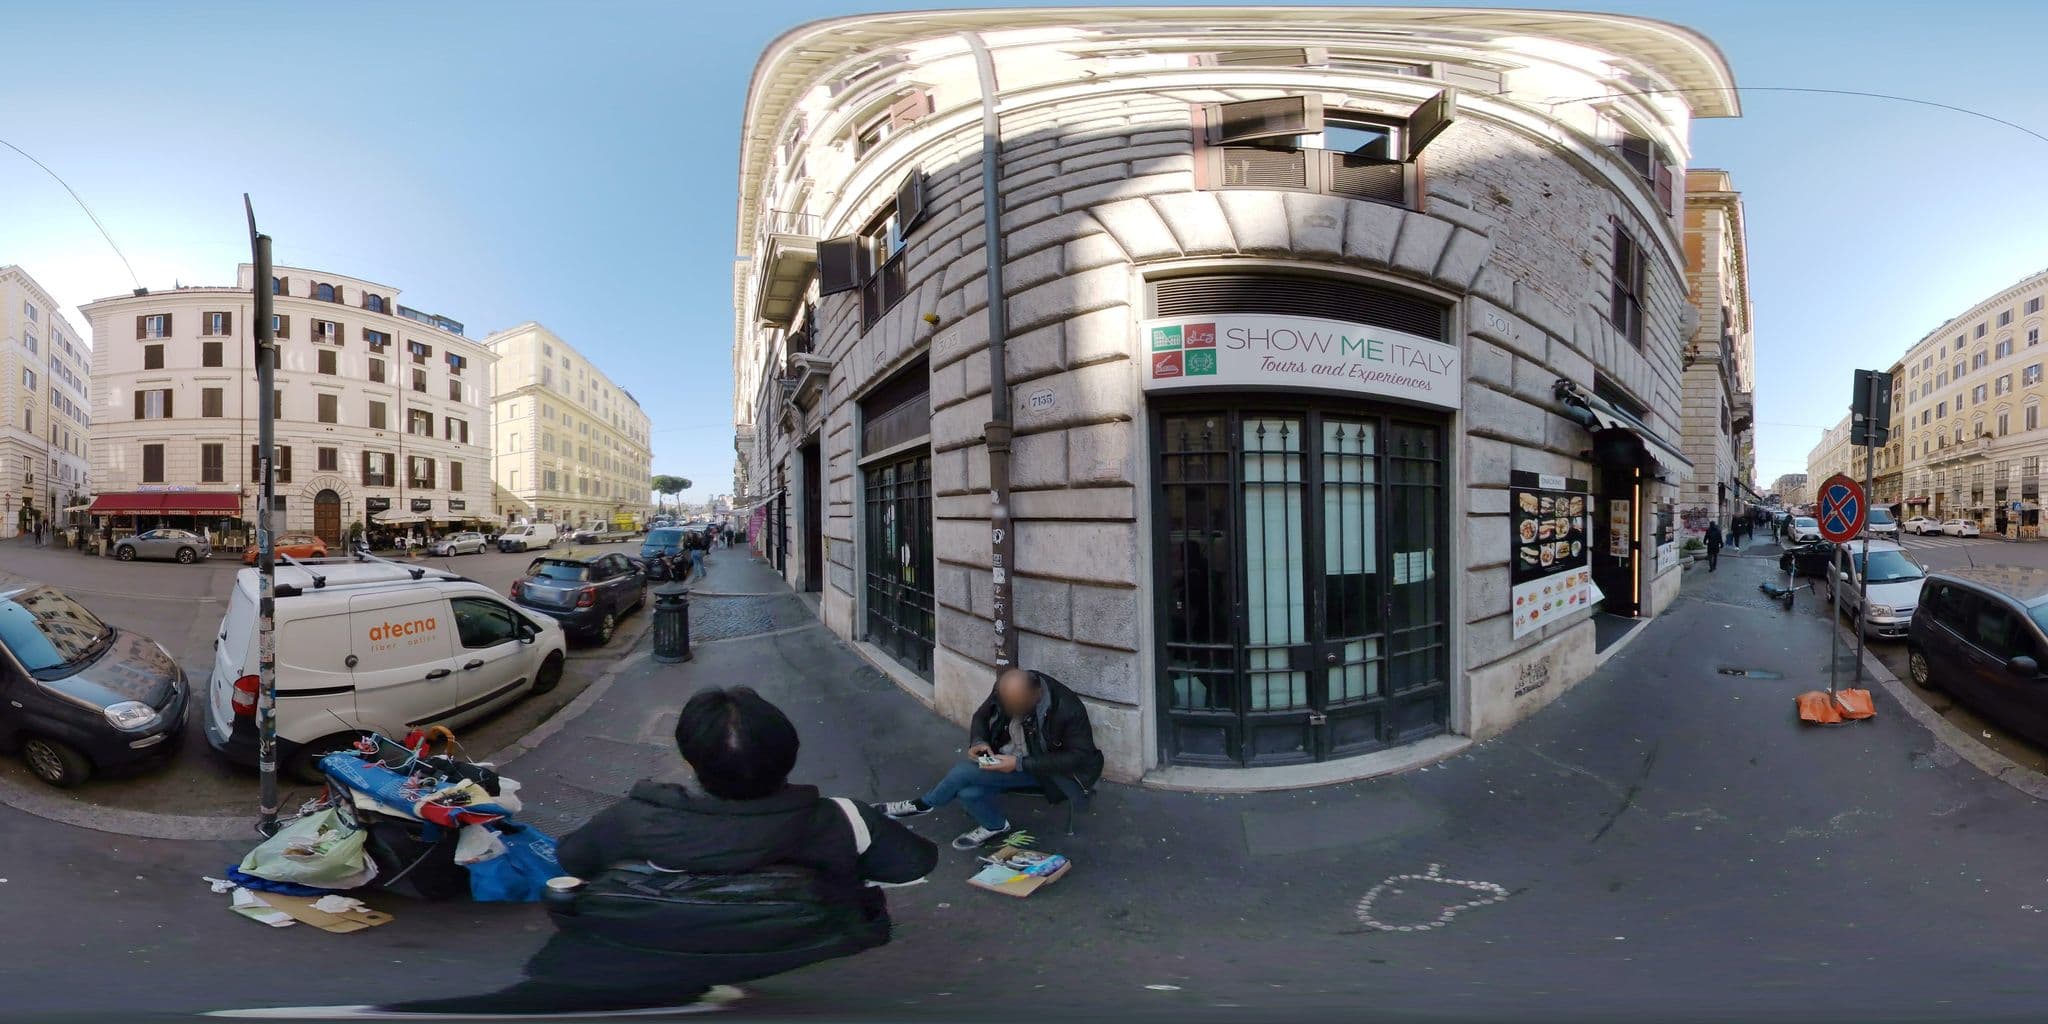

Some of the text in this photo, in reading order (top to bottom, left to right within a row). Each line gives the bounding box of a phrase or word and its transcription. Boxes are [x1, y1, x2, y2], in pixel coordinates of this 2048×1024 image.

[1487, 313, 1510, 336] 301
[1226, 327, 1454, 376] SHOW ME ITALY
[1260, 355, 1433, 392] Tours and Experiences
[369, 617, 436, 641] atecna
